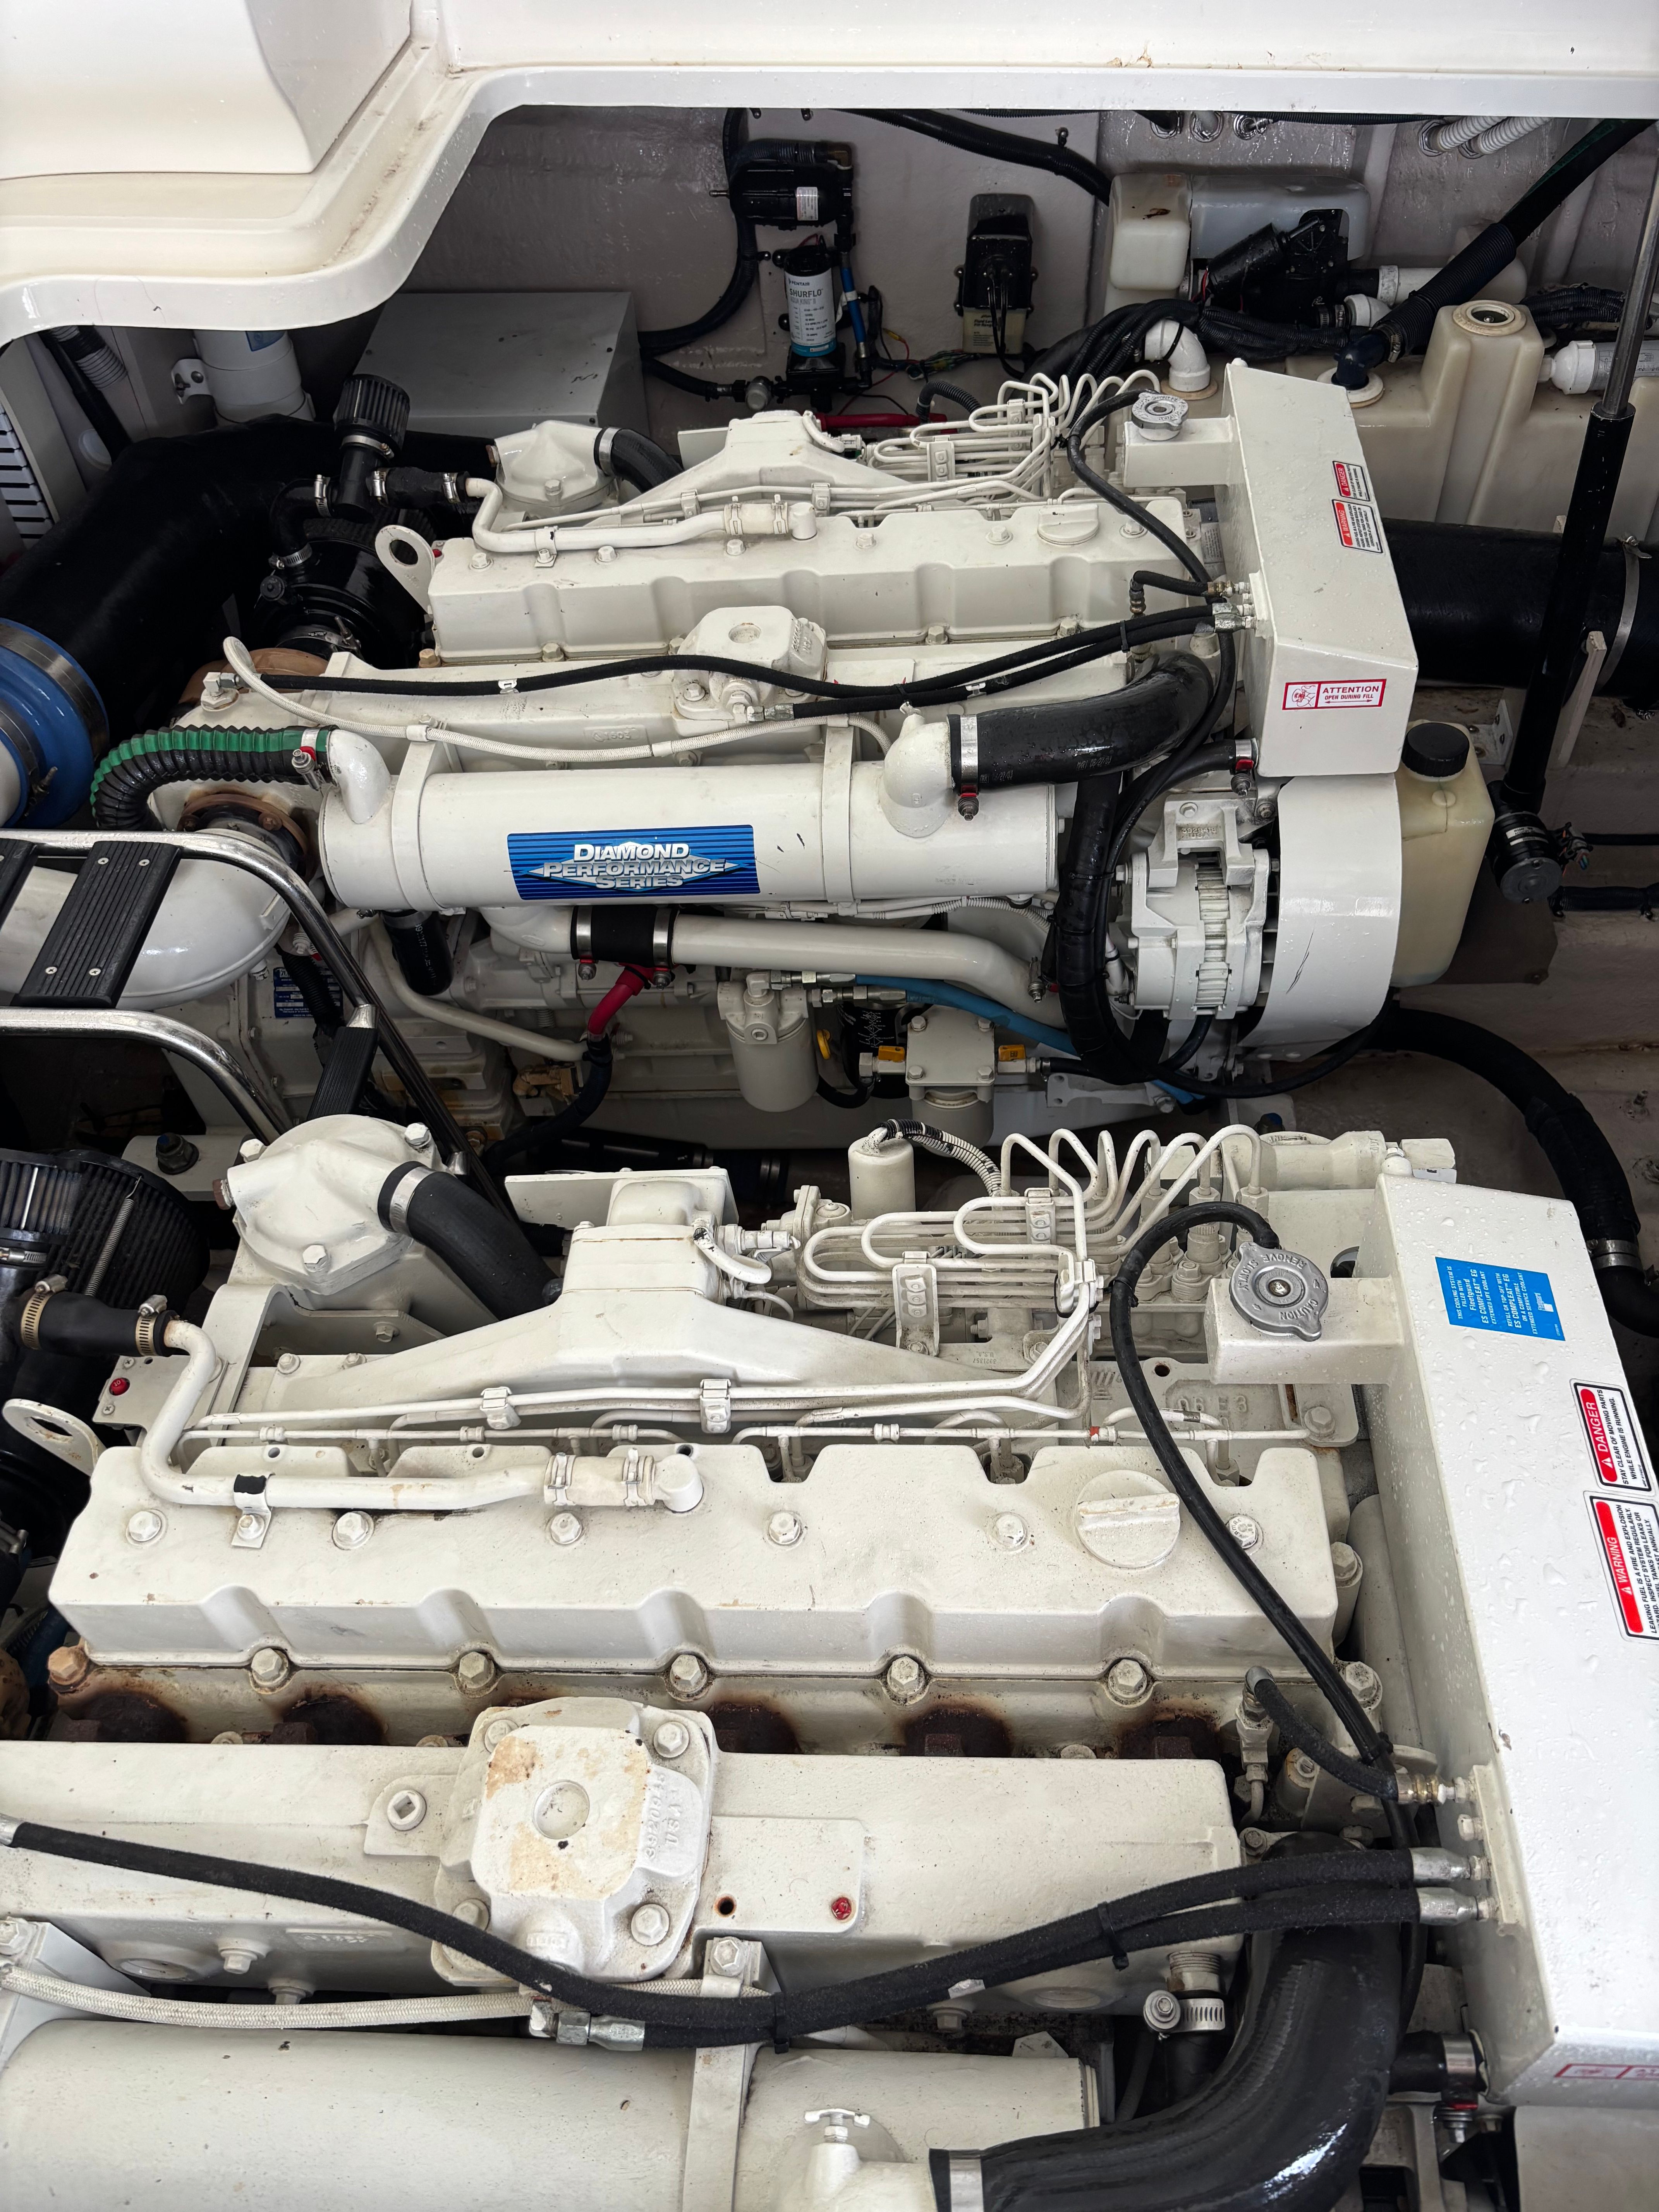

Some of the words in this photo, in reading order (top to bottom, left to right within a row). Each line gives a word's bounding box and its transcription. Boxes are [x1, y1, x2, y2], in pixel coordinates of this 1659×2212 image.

[790, 289, 822, 298] SHURFLO
[1338, 467, 1348, 486] DANGER
[1338, 509, 1349, 531] WARNING
[574, 843, 690, 862] DIAMOND
[543, 859, 726, 877] PERFORMANCE
[596, 875, 684, 888] SERIES
[1261, 1254, 1307, 1269] REMOVE
[1447, 1271, 1456, 1289] SYSTEM
[1479, 1271, 1488, 1290] COOLANT
[1502, 1273, 1510, 1281] EG
[1517, 1272, 1527, 1291] COOLANT
[1452, 1290, 1461, 1308] COOLING
[1463, 1279, 1477, 1310] Fleetguard
[1498, 1285, 1507, 1303] TOP-OFF
[1513, 1283, 1525, 1309] COMPATIBLE
[1523, 1292, 1532, 1310] SERVICE
[1279, 1299, 1318, 1320] CAUTION
[1481, 1315, 1489, 1323] ES
[1487, 1301, 1496, 1324] EXTENDED
[1504, 1312, 1513, 1326] REFILL
[1513, 1320, 1522, 1328] ES
[1528, 1312, 1538, 1334] EXTENDED
[1597, 1389, 1607, 1408] PARTS
[1608, 1397, 1622, 1425] RUNNING.
[1585, 1401, 1608, 1452] DANGER
[1603, 1410, 1614, 1434] MOVING
[1610, 1436, 1617, 1444] OF
[1619, 1434, 1631, 1458] ENGINE
[1613, 1446, 1624, 1467] CLEAR
[1620, 1469, 1629, 1484] STAY
[1626, 1460, 1637, 1479] WHILE
[1616, 1504, 1630, 1540] EXPLOSION
[1625, 1507, 1640, 1545] REGULARLY.
[1634, 1512, 1641, 1521] OR
[1637, 1523, 1648, 1543] LEAKS
[1644, 1518, 1659, 1552] ANNUALLY.
[1626, 1541, 1635, 1554] AND
[1643, 1545, 1652, 1558] FOR
[1606, 1536, 1628, 1583] WARNING
[1630, 1556, 1639, 1570] FIRE
[1636, 1547, 1648, 1572] SYSTEM
[1647, 1559, 1658, 1580] TANKS
[1638, 1585, 1648, 1602] FUEL
[1644, 1574, 1656, 1601] INSPECT
[1644, 1604, 1657, 1633] LEAKING
